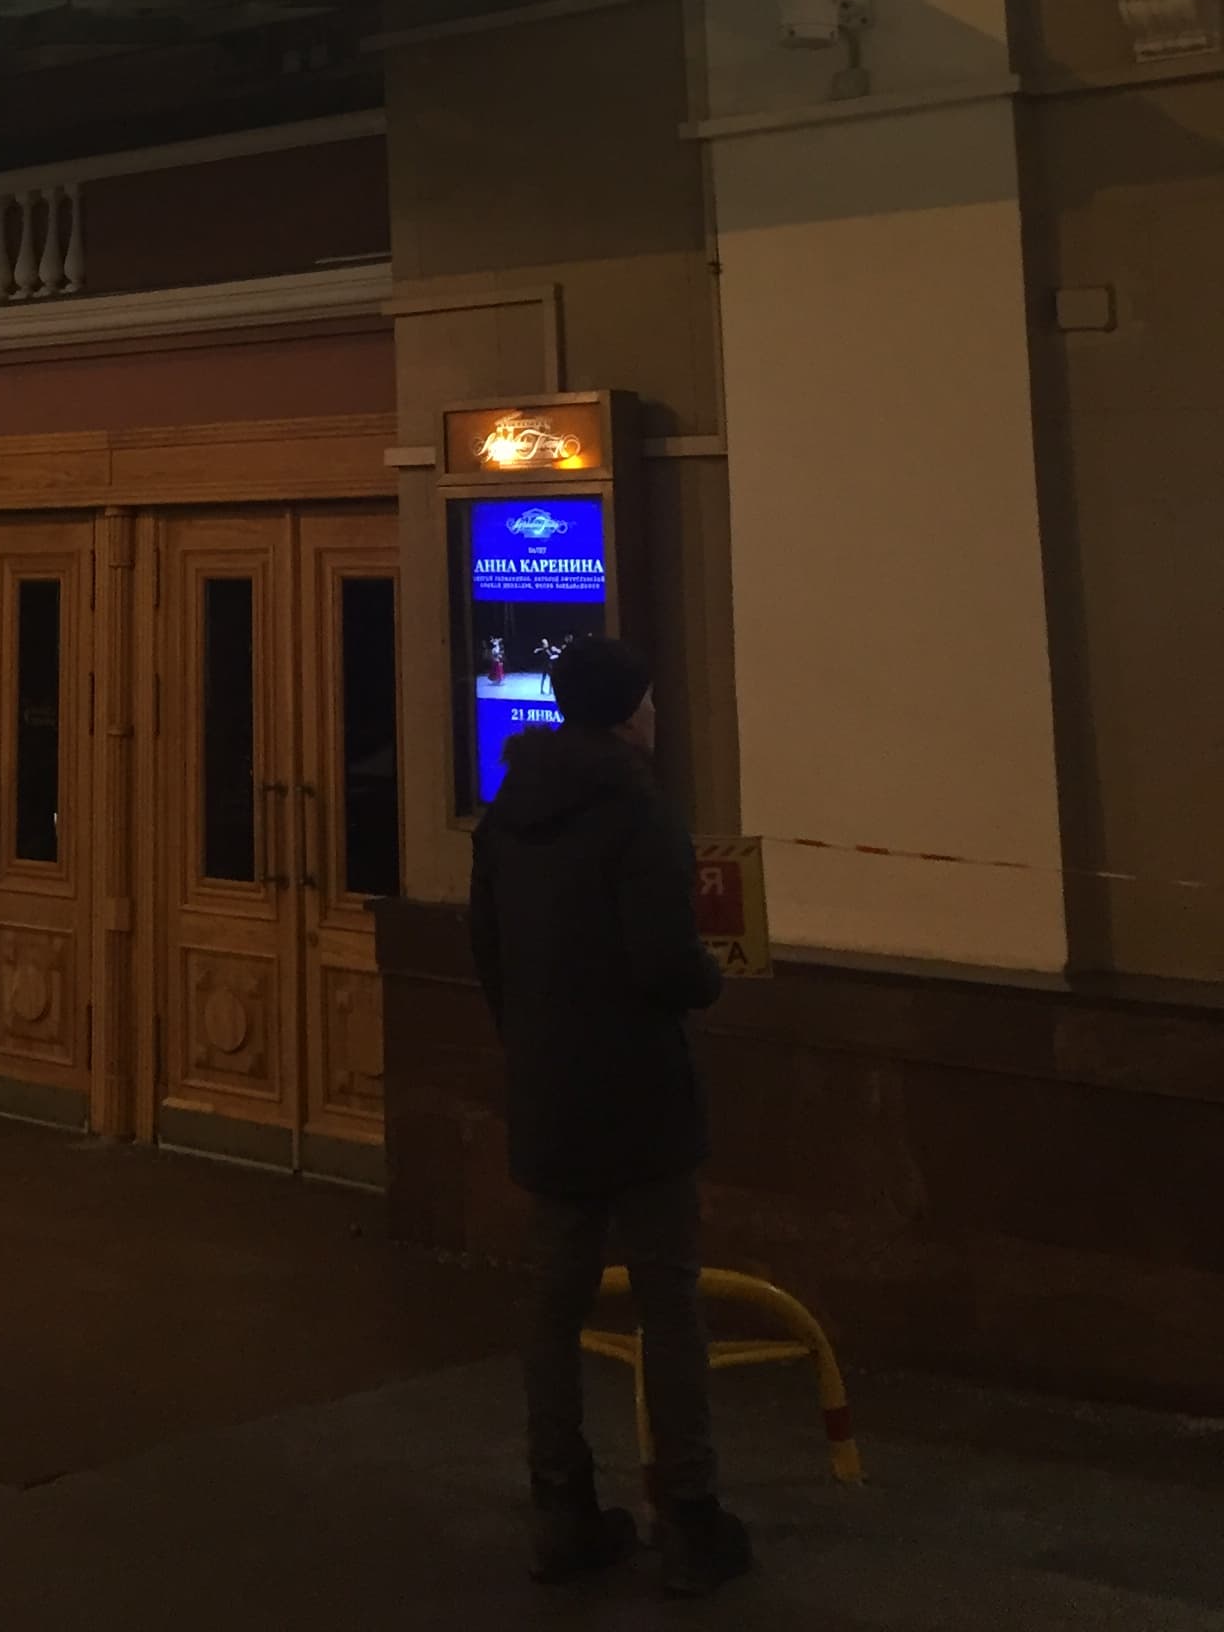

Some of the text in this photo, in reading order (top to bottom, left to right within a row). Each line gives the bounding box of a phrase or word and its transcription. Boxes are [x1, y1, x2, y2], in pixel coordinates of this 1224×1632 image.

[474, 559, 604, 573] АННА КАРЕНИНА
[511, 708, 565, 723] 21 ЯНВА
